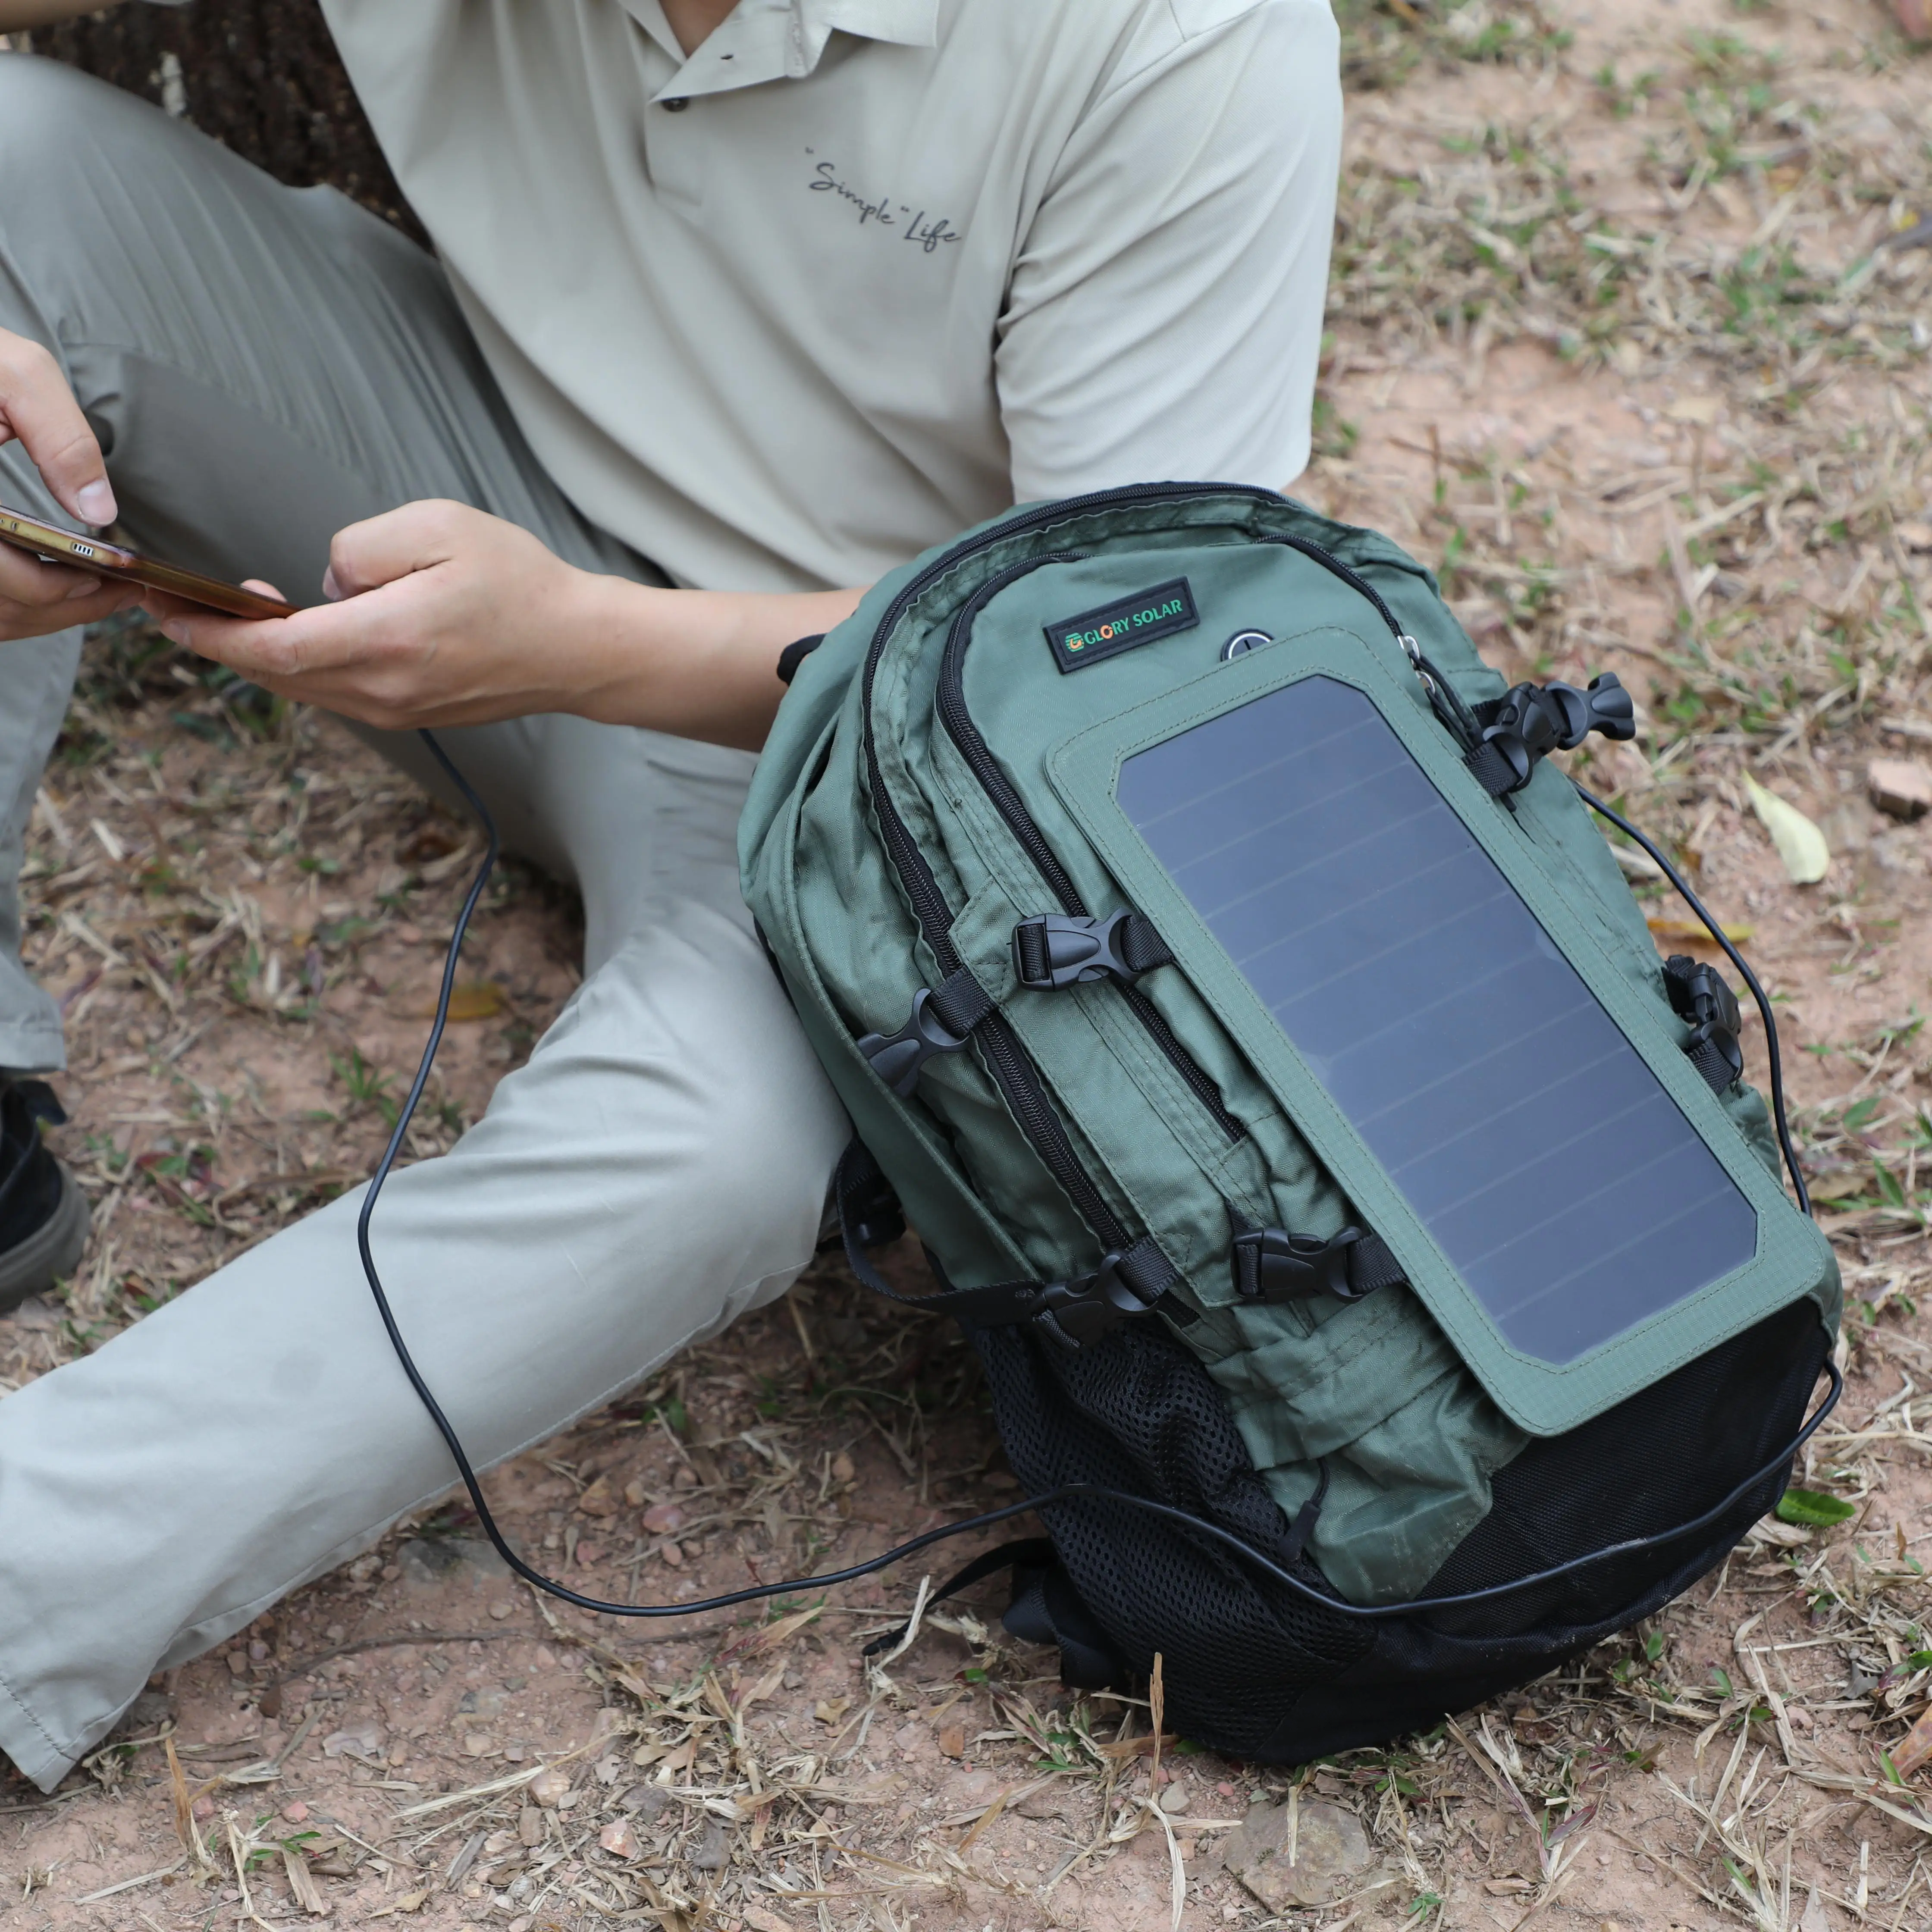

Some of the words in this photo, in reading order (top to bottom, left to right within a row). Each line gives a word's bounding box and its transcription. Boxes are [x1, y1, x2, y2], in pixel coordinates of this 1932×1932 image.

[904, 211, 962, 252] Life
[1084, 617, 1129, 644] GLORY
[1133, 599, 1183, 627] SOLAR
